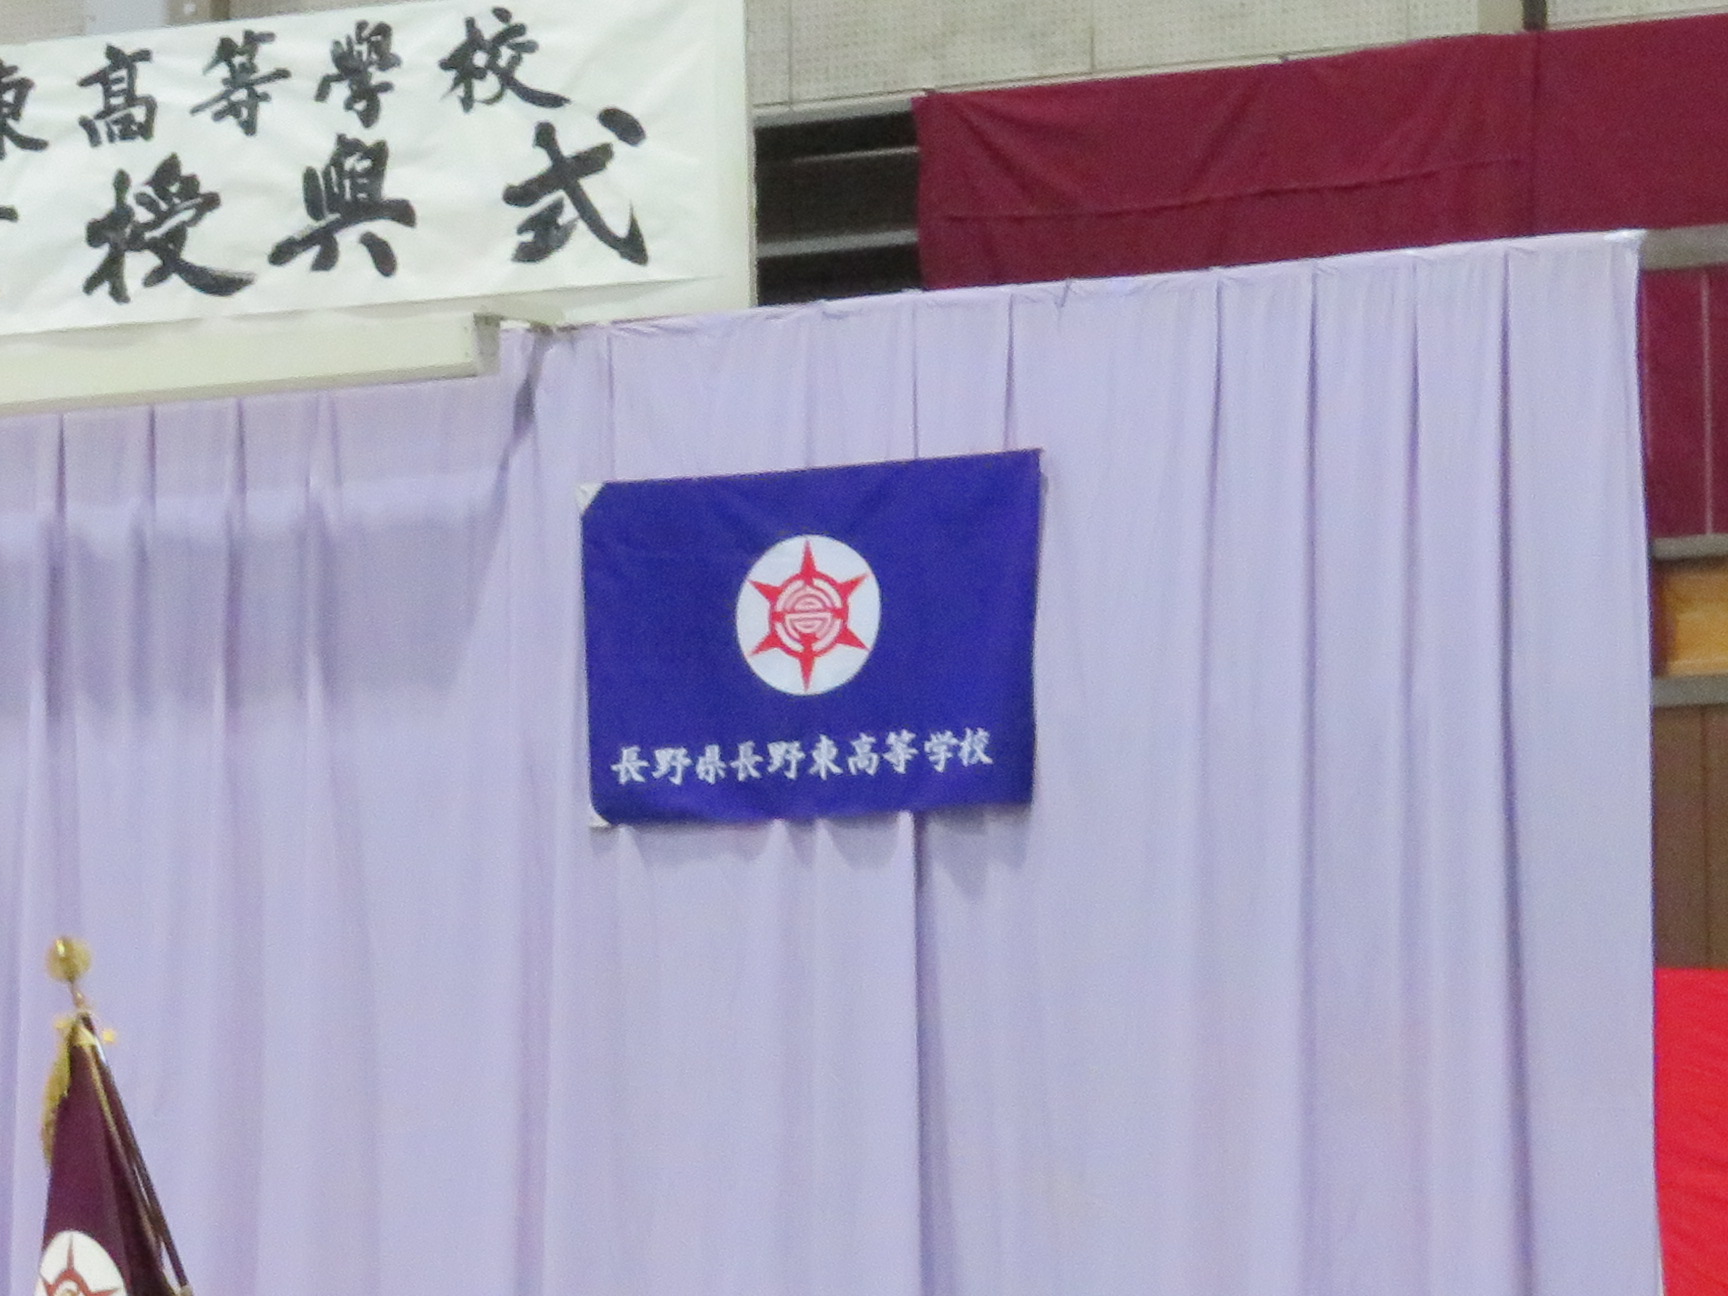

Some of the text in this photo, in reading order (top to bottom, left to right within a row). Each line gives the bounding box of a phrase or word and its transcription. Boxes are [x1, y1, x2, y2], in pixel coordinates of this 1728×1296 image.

[610, 726, 994, 785] 長野県長野東高等学校
